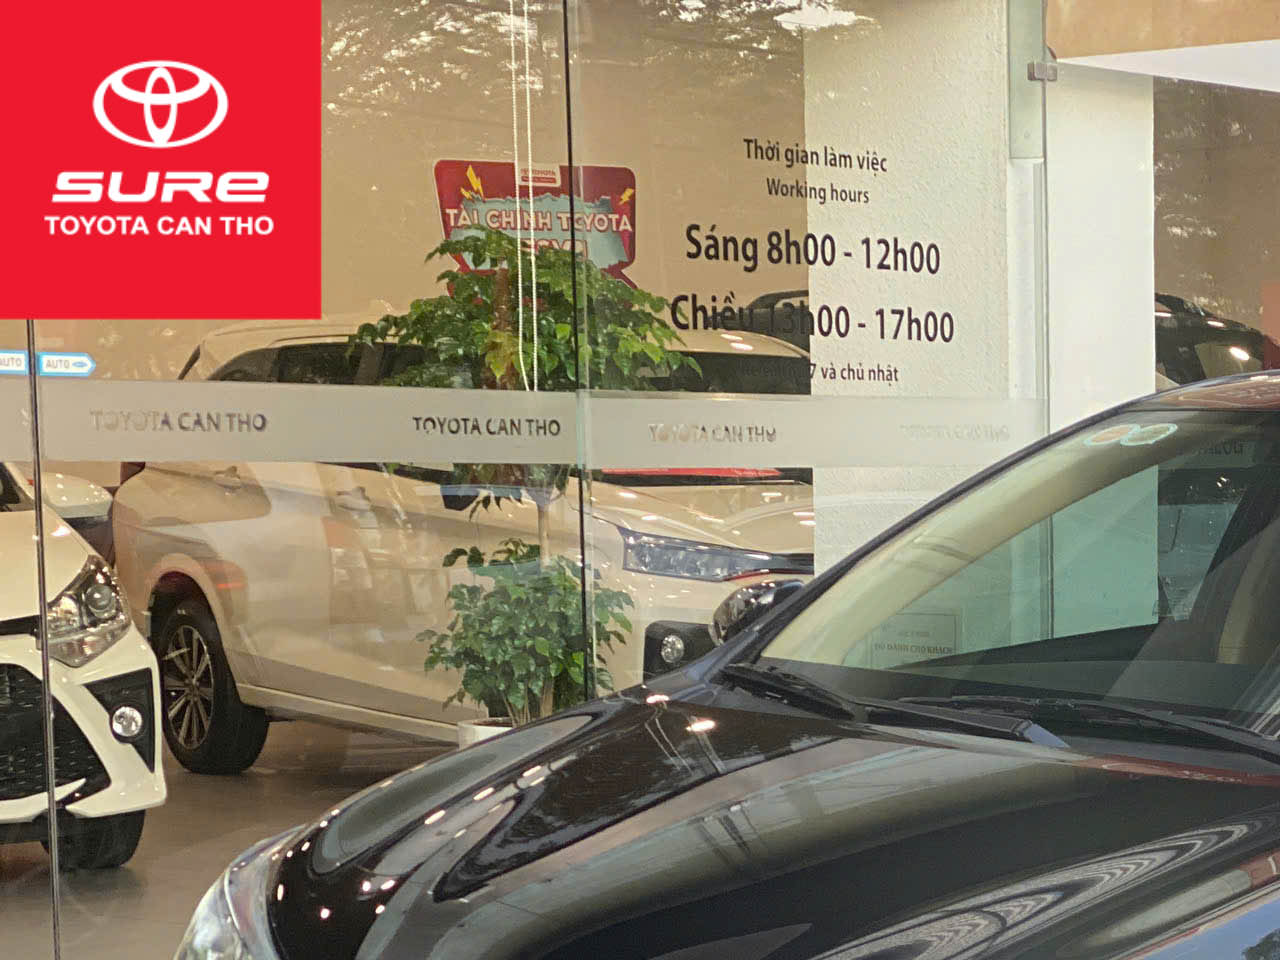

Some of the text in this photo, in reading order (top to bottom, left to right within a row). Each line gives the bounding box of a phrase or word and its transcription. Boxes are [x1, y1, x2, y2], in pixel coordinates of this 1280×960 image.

[743, 138, 888, 177] Thời gian làm việc
[766, 178, 869, 205] Working hours
[446, 203, 479, 227] TÀI
[686, 223, 758, 273] Sáng
[767, 229, 836, 267] 8h00
[861, 237, 941, 275] 12h00
[670, 290, 753, 331] Chiều
[875, 307, 954, 343] 17h00
[45, 359, 71, 370] AUTO
[821, 364, 837, 379] và
[840, 362, 864, 381] chủ
[868, 364, 898, 387] nhật
[90, 411, 268, 433] TOYOTA CAN THO
[413, 417, 561, 436] TOYOTA CAN THO
[711, 424, 743, 443] CAN
